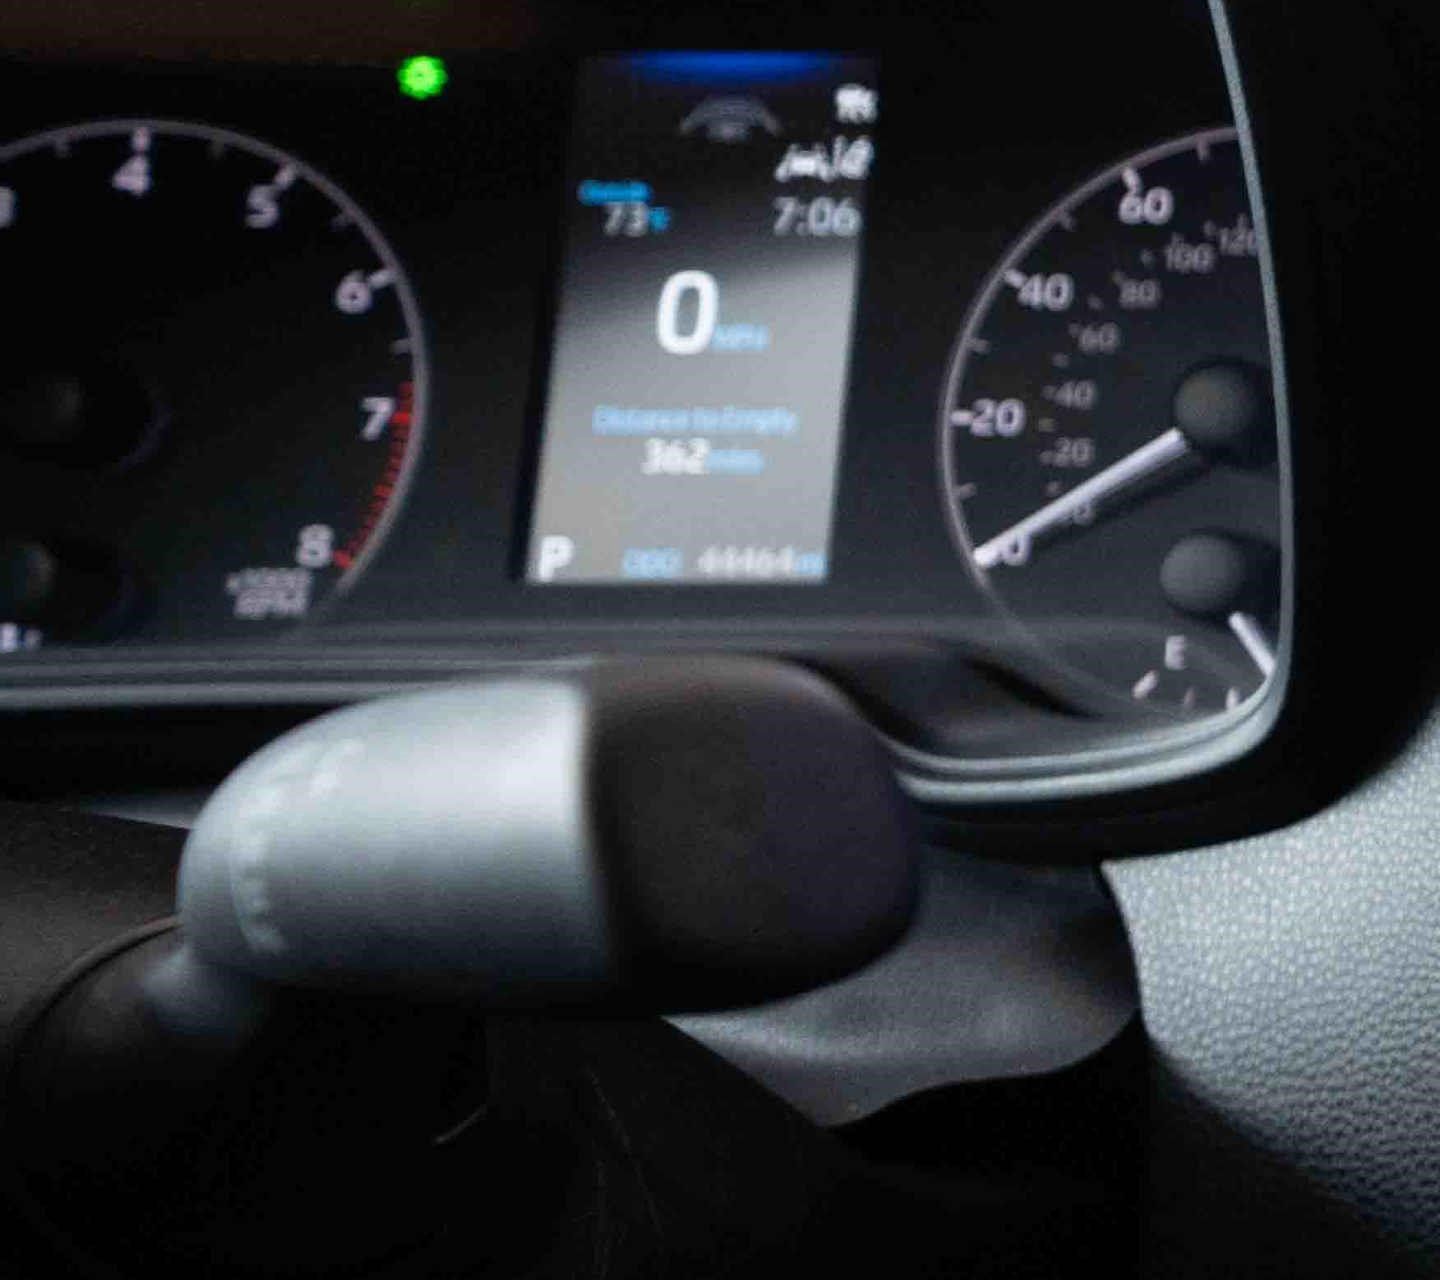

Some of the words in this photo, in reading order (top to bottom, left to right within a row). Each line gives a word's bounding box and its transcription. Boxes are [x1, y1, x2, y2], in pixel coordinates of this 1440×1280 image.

[112, 154, 152, 197] 4
[244, 185, 280, 229] 5
[772, 197, 862, 237] 7:06
[1118, 186, 1174, 225] 60
[335, 270, 372, 315] 6
[655, 269, 719, 355] 0
[1016, 271, 1075, 312] 40
[359, 396, 395, 440] 7
[969, 397, 1026, 437] 20
[295, 523, 335, 568] 8
[538, 536, 575, 583] P
